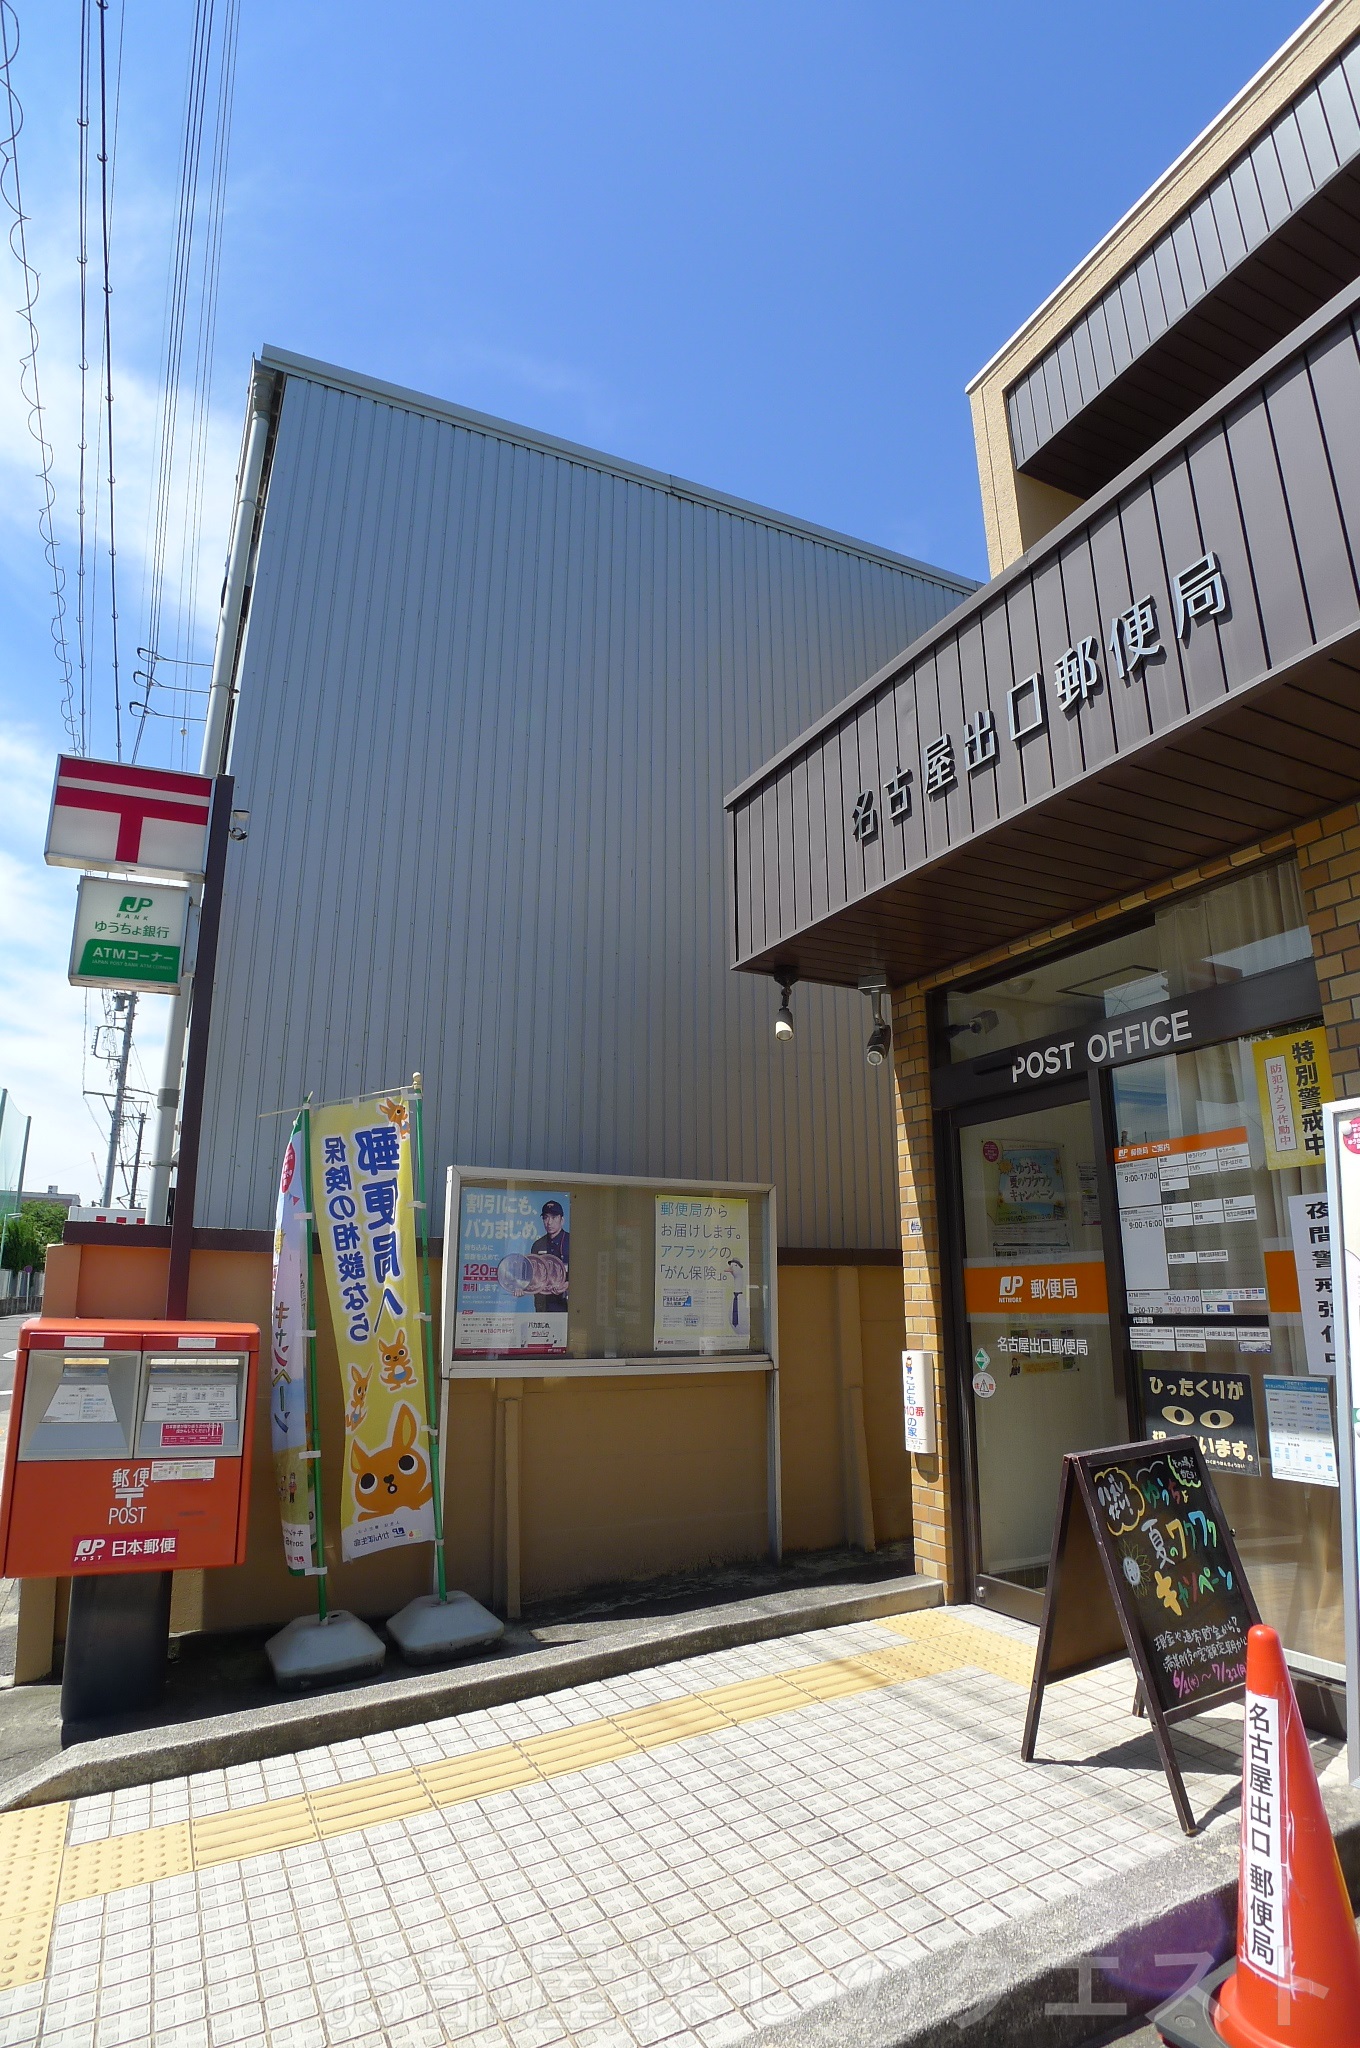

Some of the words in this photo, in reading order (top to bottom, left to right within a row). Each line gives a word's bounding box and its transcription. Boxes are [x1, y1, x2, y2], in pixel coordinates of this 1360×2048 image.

[853, 551, 1227, 840] 名古屋出口郵便局
[118, 896, 153, 913] JP
[116, 913, 148, 921] BANK
[94, 920, 170, 939] ゆうちょ銀行
[93, 947, 173, 962] ATMコーナー
[1011, 1042, 1074, 1083] POST
[1087, 1010, 1193, 1063] OFFICE
[1270, 1063, 1291, 1146] 防犯カメラ作動中
[1292, 1040, 1325, 1156] 特別警戒中
[1124, 1171, 1158, 1183] 9:00-17:00
[466, 1194, 537, 1216] 割引にも、
[1009, 1189, 1055, 1202] キャンペーン
[660, 1202, 728, 1218] 郵便局から
[465, 1219, 541, 1240] バカまじめ。
[661, 1223, 741, 1240] お届けします。
[1128, 1219, 1163, 1230] 9:00-16:00
[660, 1245, 732, 1259] アフラックの
[463, 1263, 498, 1276] 120円
[660, 1264, 728, 1281] 「がん保険」。
[463, 1283, 500, 1292] 割引します。
[1030, 1278, 1078, 1300] 郵便局
[997, 1335, 1089, 1356] 名古屋出口郵便局
[1149, 1376, 1244, 1401] ひったくりが
[112, 1467, 150, 1489] 郵便
[1141, 1478, 1189, 1509] ゆうちょ
[108, 1506, 147, 1525] POST
[111, 1537, 176, 1557] 日本郵便
[1141, 1511, 1217, 1570] 夏のワクワク
[73, 1554, 103, 1562] POST
[1249, 1702, 1275, 1966] 名古屋出口郵便局
